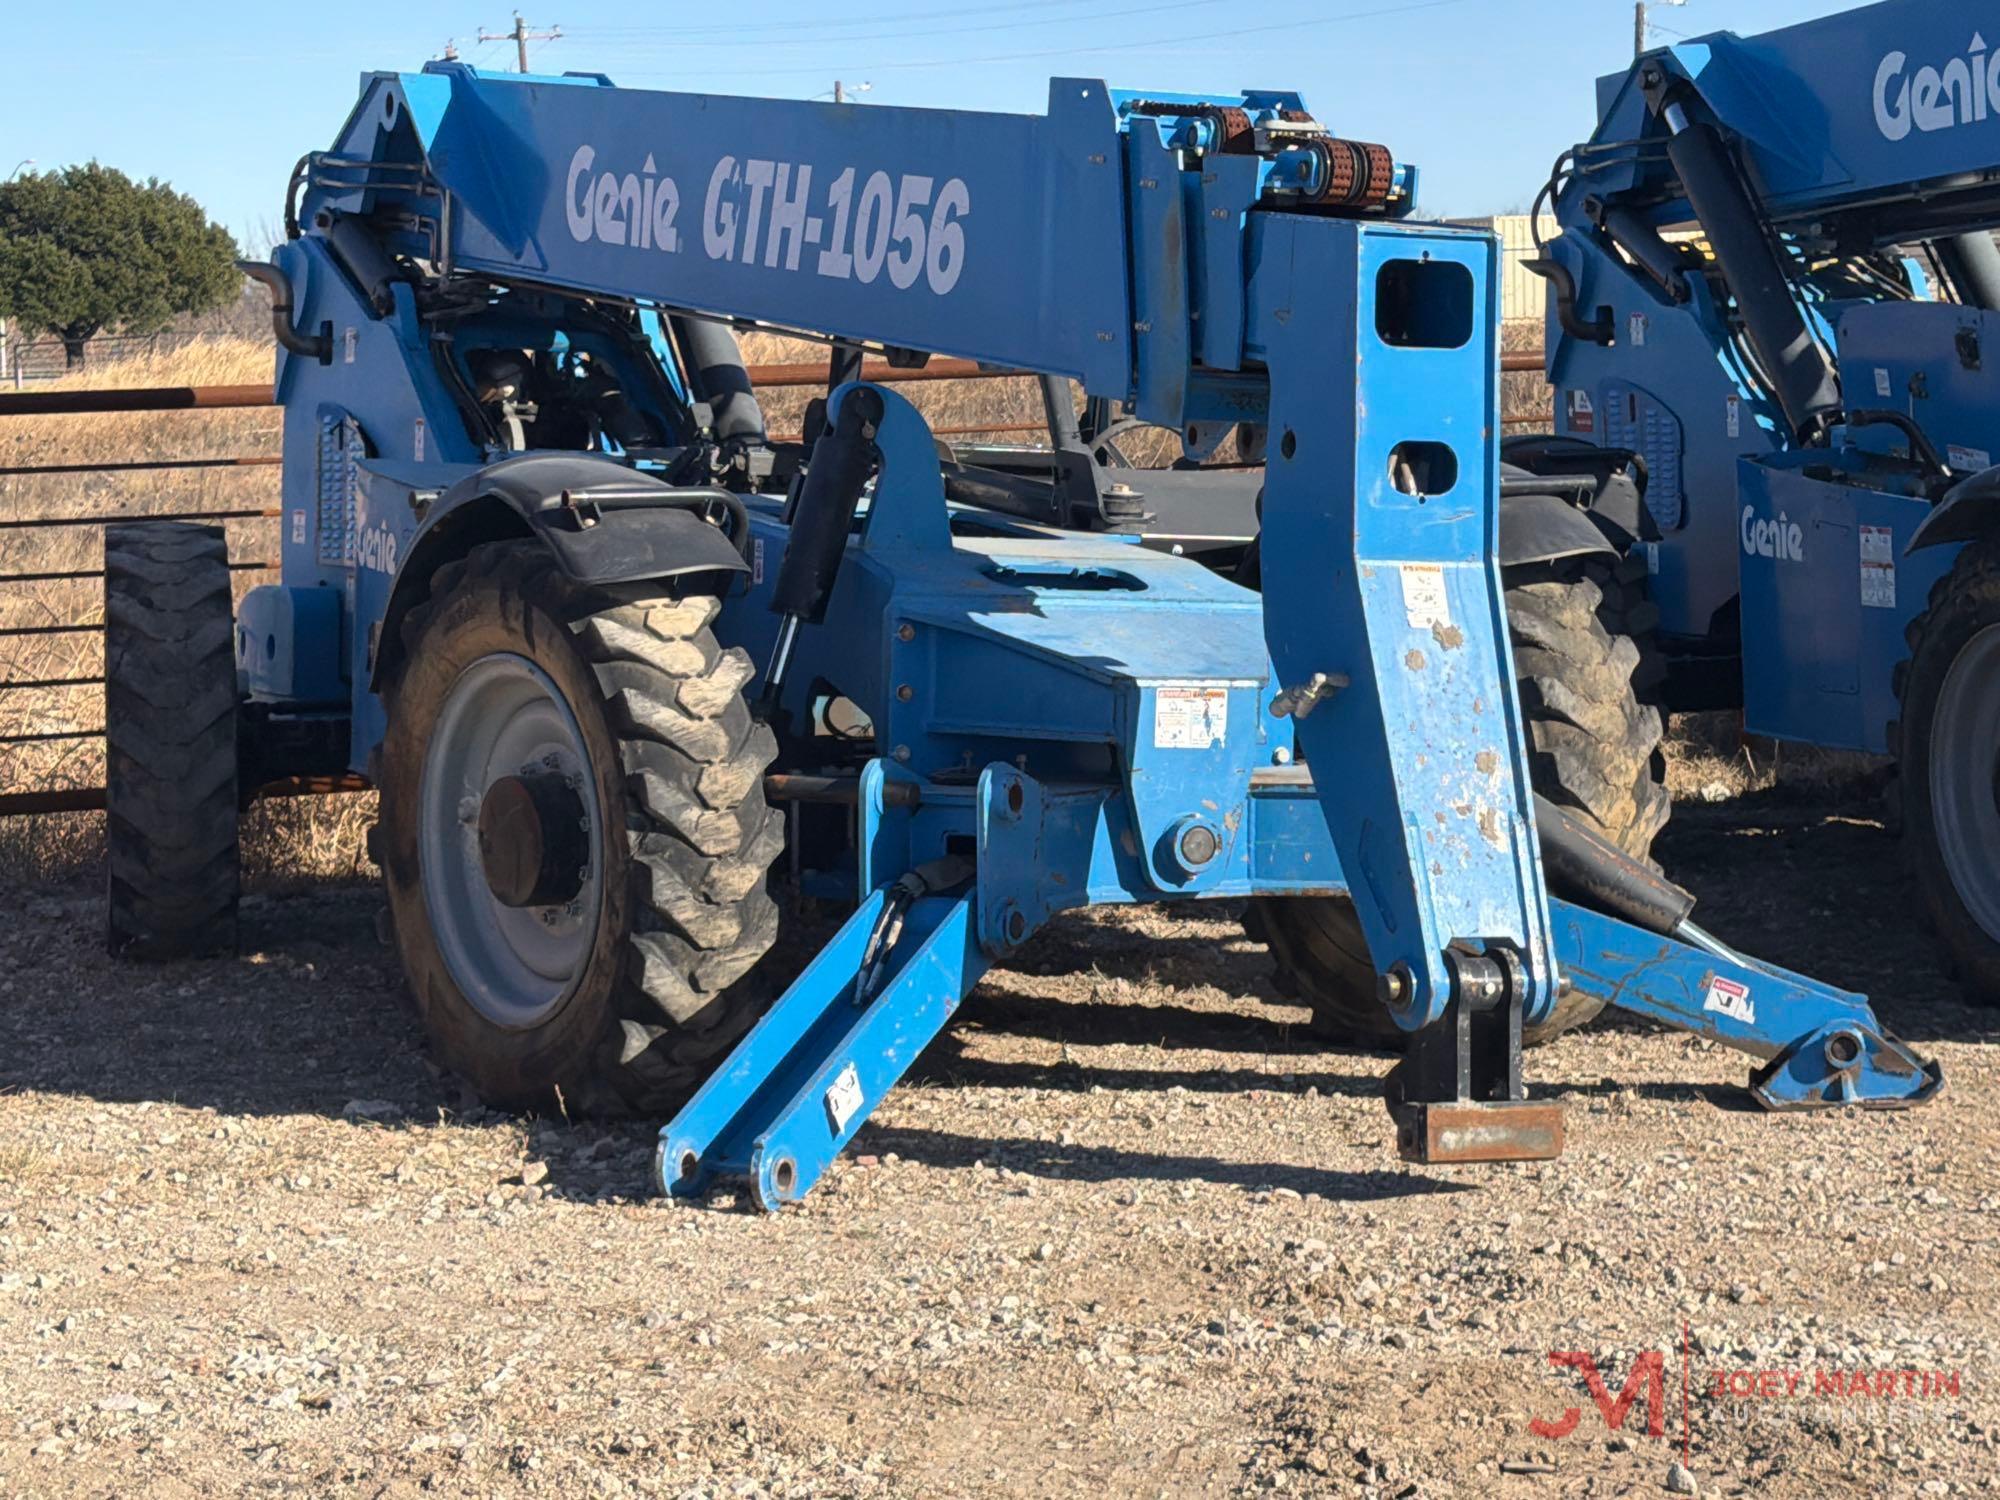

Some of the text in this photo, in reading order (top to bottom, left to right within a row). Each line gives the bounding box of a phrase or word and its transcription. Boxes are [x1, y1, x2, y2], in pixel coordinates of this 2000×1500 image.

[566, 144, 970, 296] Genie GTH-1056
[1741, 504, 1803, 562] Genie
